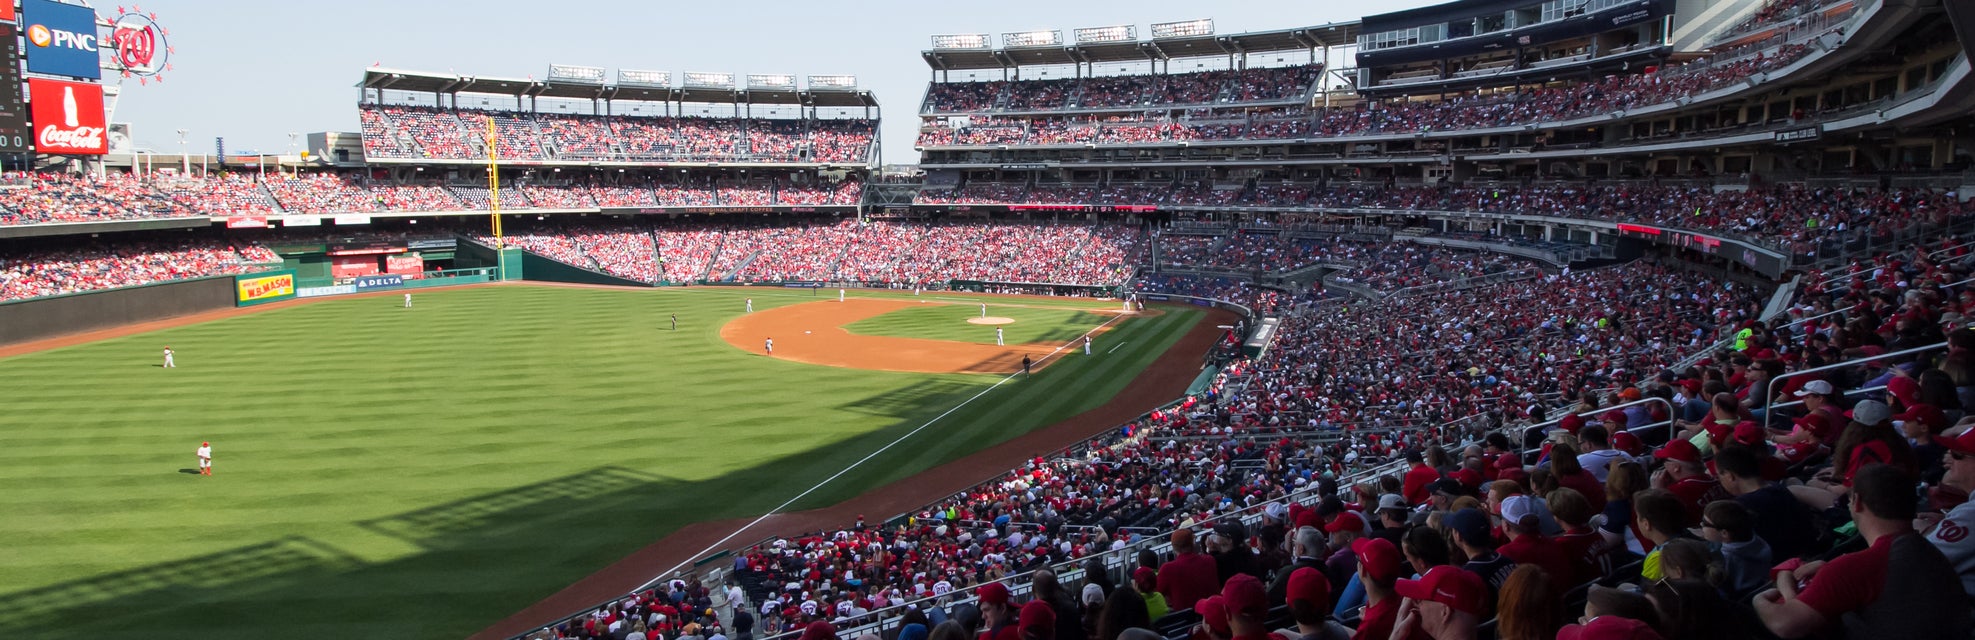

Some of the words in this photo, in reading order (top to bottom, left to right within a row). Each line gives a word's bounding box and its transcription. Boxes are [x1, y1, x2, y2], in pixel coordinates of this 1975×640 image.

[51, 29, 97, 52] PNC
[14, 135, 22, 147] 0
[40, 124, 104, 149] Coca-Cola
[369, 277, 401, 286] DELTA
